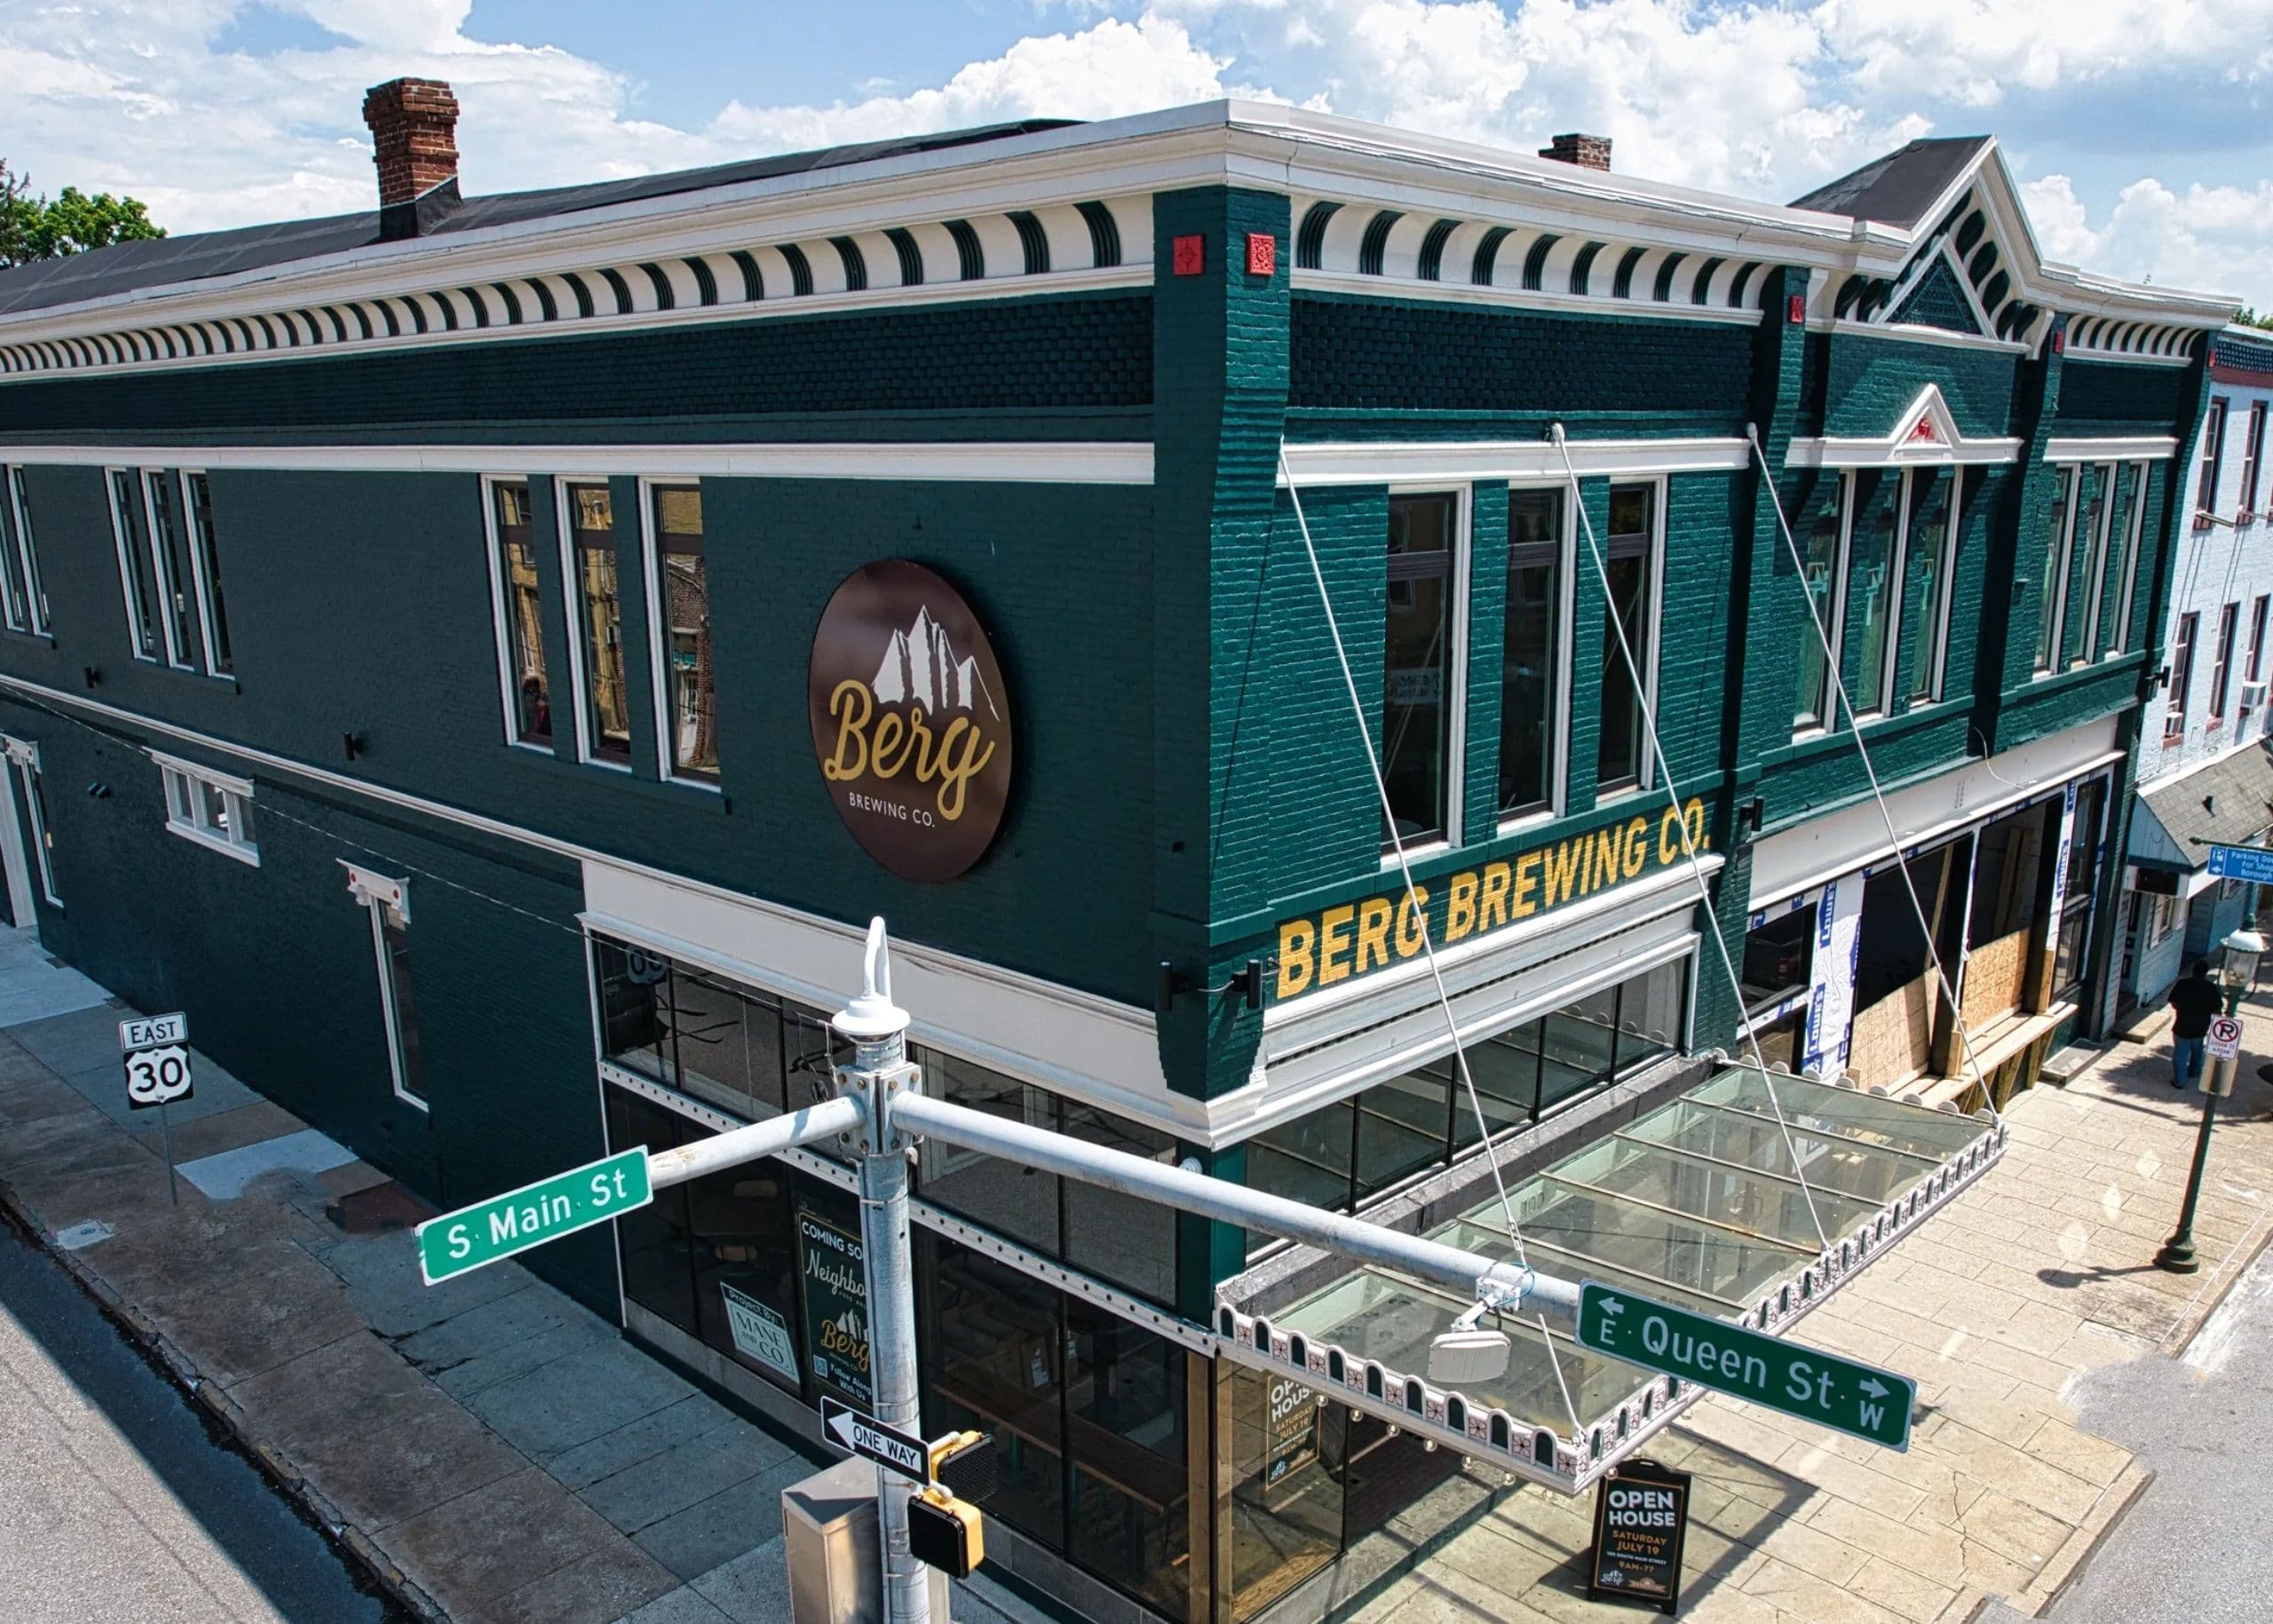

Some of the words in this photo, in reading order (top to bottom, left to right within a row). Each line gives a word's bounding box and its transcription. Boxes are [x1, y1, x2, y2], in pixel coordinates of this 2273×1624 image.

[825, 679, 995, 820] Berg
[849, 792, 907, 820] BREWING
[913, 809, 936, 828] CO.
[2231, 852, 2260, 863] Parking
[2241, 868, 2273, 880] Borough
[1277, 885, 1430, 999] BERG
[1445, 817, 1647, 943] BREWING
[1658, 797, 1710, 866] CO.
[130, 1021, 176, 1044] EAST
[1809, 989, 1825, 1051] LOWE'S
[133, 1057, 183, 1093] 30
[447, 1224, 471, 1258] S
[489, 1195, 571, 1245] Main
[590, 1168, 627, 1207] St
[802, 1222, 844, 1252] COMING
[848, 1242, 863, 1260] SO
[805, 1248, 867, 1297] Neighbo
[736, 1311, 784, 1350] MANE
[820, 1319, 869, 1372] Berg
[1600, 1319, 1617, 1346] E
[1642, 1315, 1767, 1390] Queen
[1785, 1360, 1834, 1410] St
[1859, 1399, 1885, 1431] W
[1271, 1380, 1299, 1404] OP
[1271, 1387, 1313, 1422] HOUS
[1276, 1405, 1313, 1433] SATURDAY
[1279, 1422, 1299, 1443] JULY
[853, 1425, 883, 1453] ONE
[886, 1438, 917, 1467] WAY
[1609, 1491, 1675, 1509] OPEN
[1609, 1510, 1675, 1527] HOUSE
[1612, 1529, 1667, 1547] SATURDAY
[1617, 1541, 1644, 1552] JULY
[1647, 1545, 1659, 1556] 19
